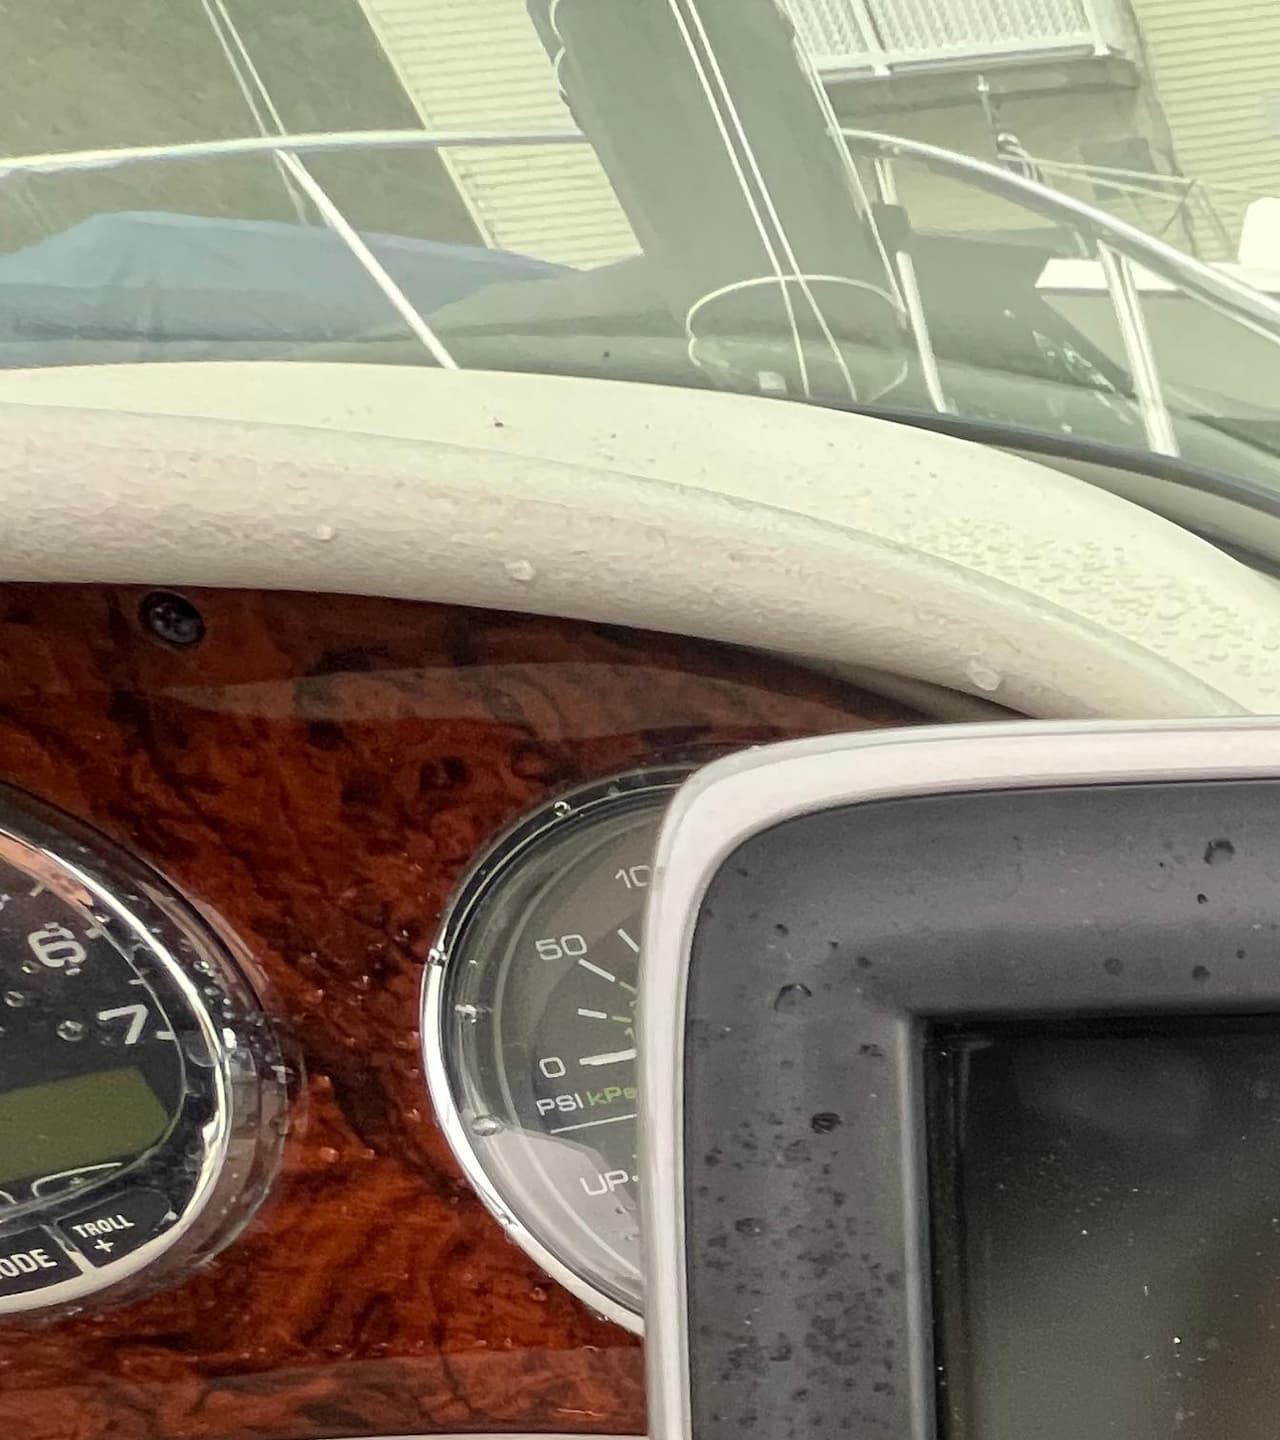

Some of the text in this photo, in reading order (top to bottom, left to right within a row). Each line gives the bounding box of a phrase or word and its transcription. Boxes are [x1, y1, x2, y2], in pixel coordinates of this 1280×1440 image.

[28, 927, 87, 968] 6
[535, 934, 588, 961] 50
[97, 1004, 148, 1044] 7
[539, 1056, 566, 1079] 0
[536, 1093, 584, 1116] PSI
[580, 1169, 630, 1196] UP
[72, 1214, 135, 1239] TROLL
[0, 1249, 58, 1280] ODE
